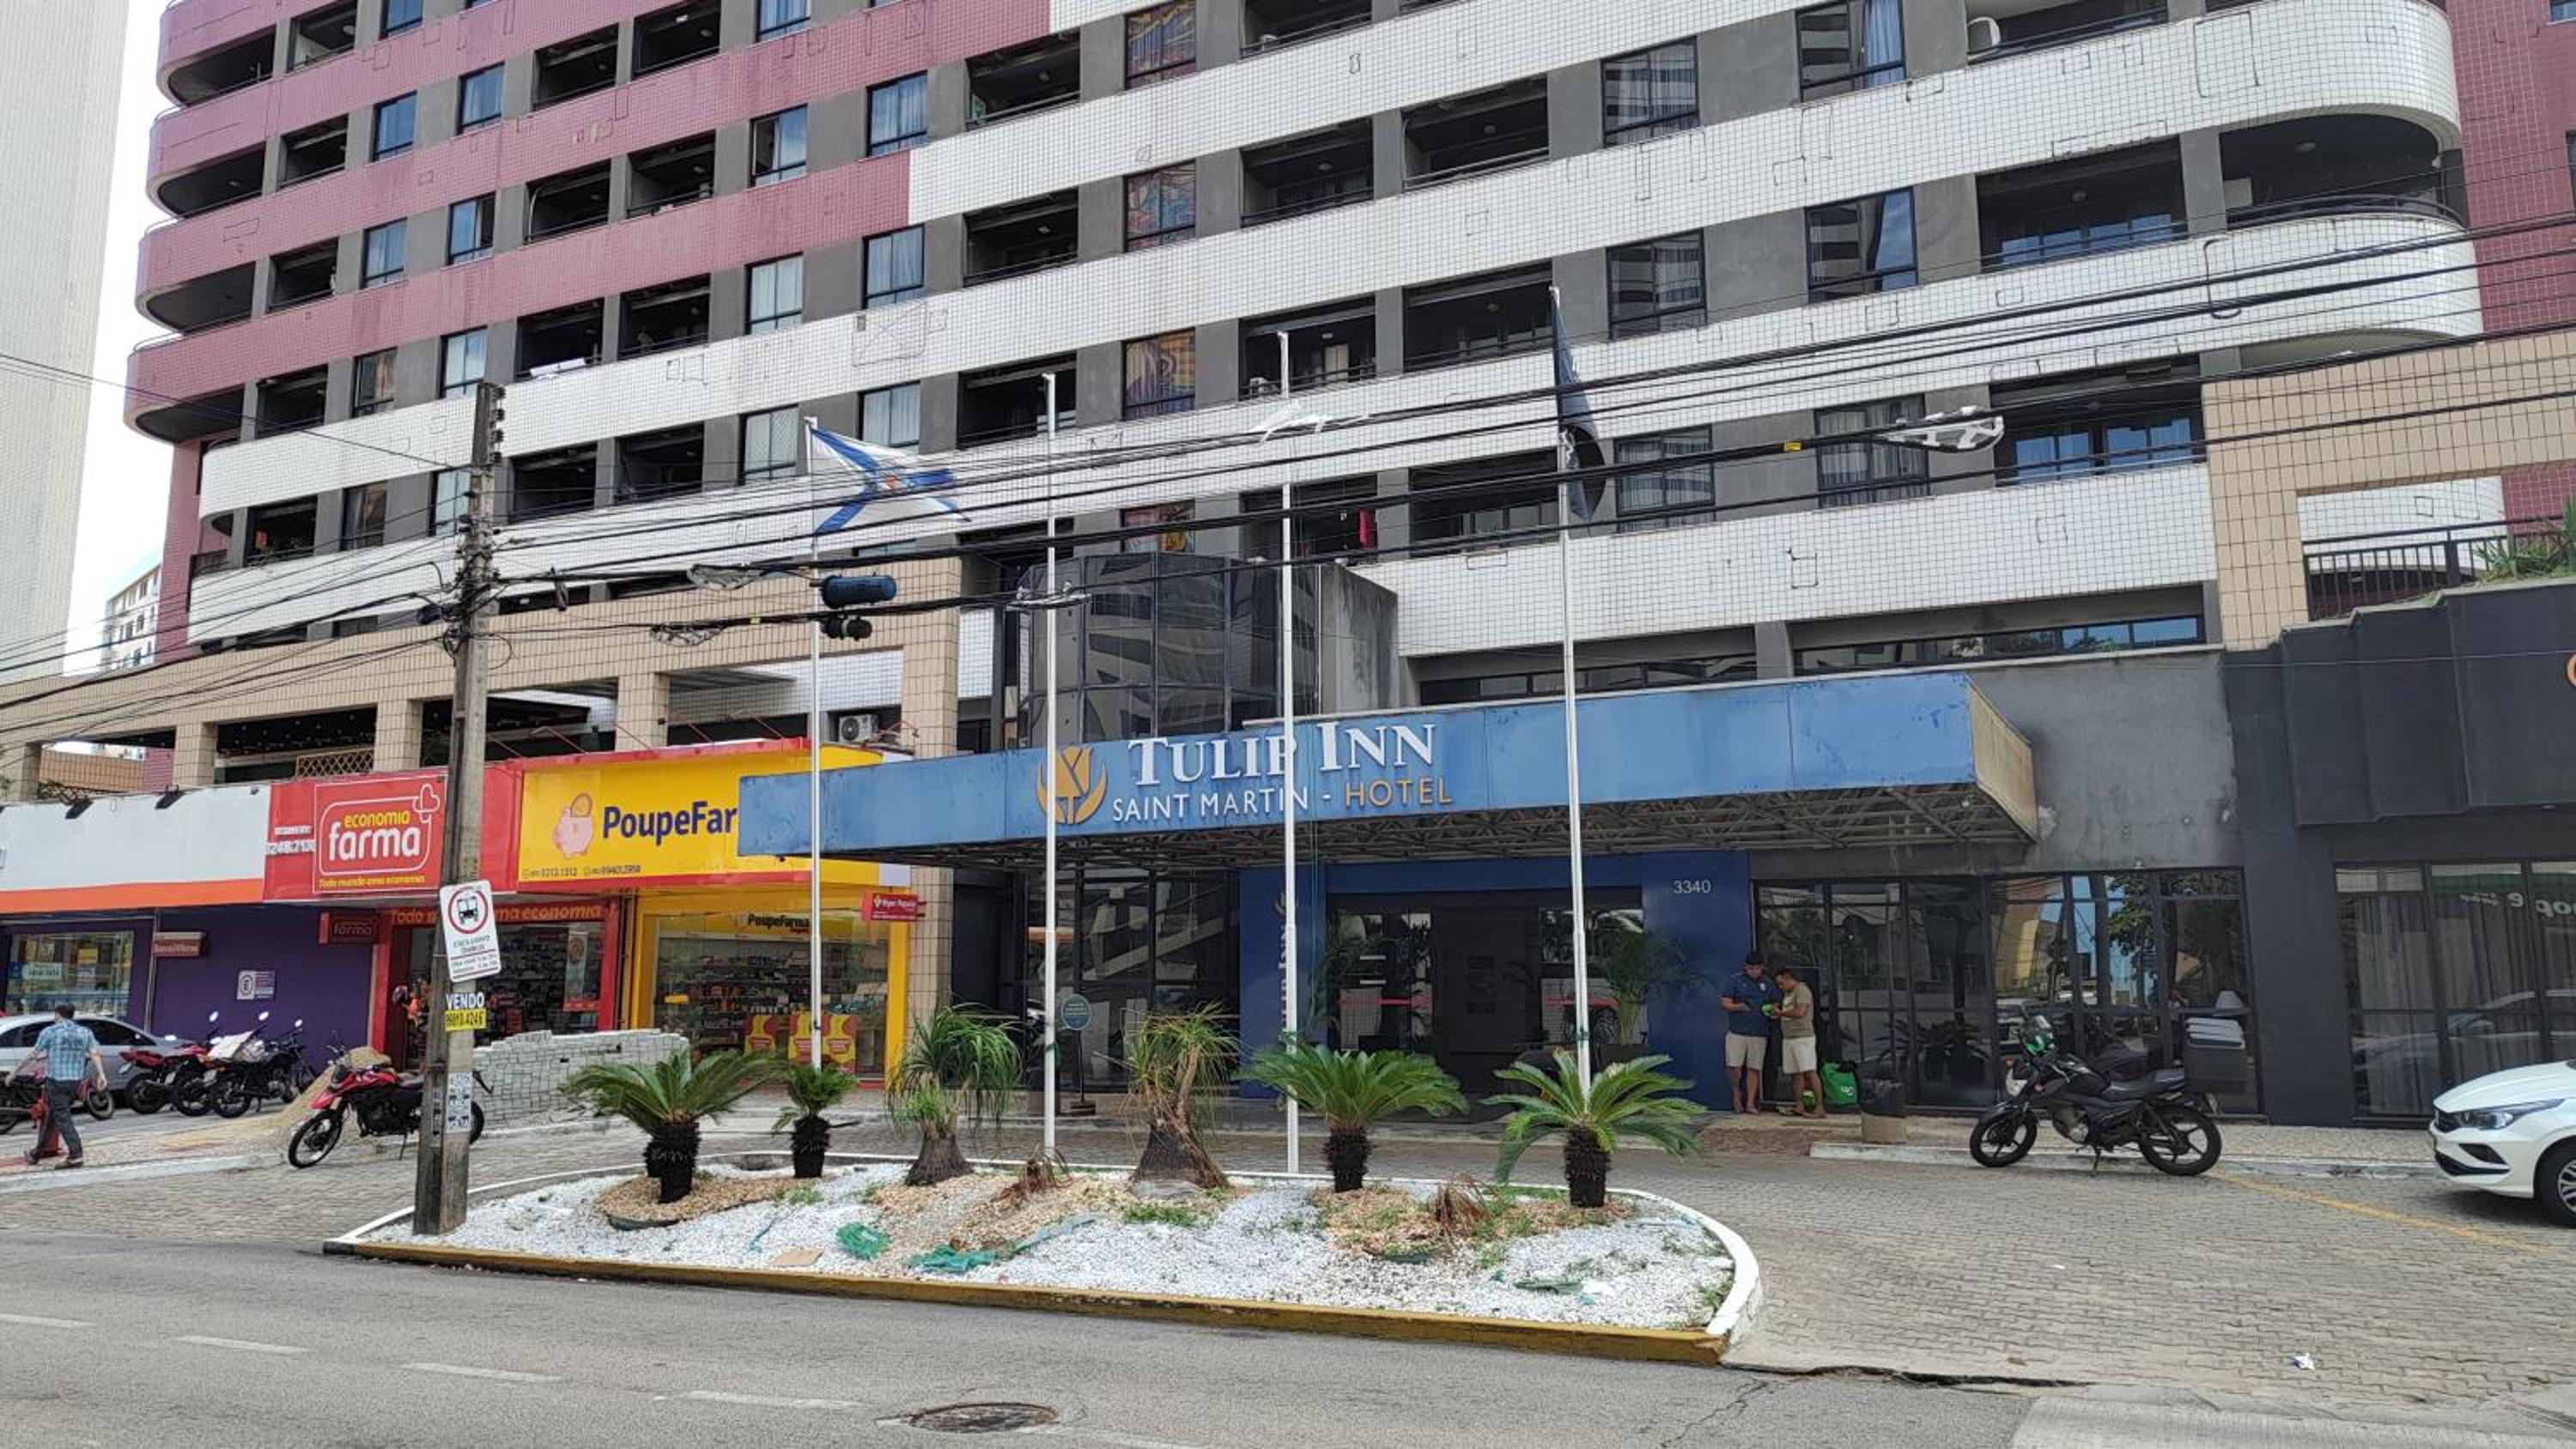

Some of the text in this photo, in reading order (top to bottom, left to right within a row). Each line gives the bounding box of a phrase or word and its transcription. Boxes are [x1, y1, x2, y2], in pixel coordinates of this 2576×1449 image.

[1127, 721, 1437, 786] TULIP INN
[1112, 792, 1188, 822] SAINT
[1200, 785, 1309, 818] MARTIN
[1344, 776, 1455, 808] HOTEL
[344, 810, 410, 828] economia
[602, 800, 738, 846] PoupeFar
[328, 822, 421, 861] farma
[1674, 879, 1711, 894] 3340
[521, 906, 602, 921] economia
[446, 991, 485, 1010] VENDO
